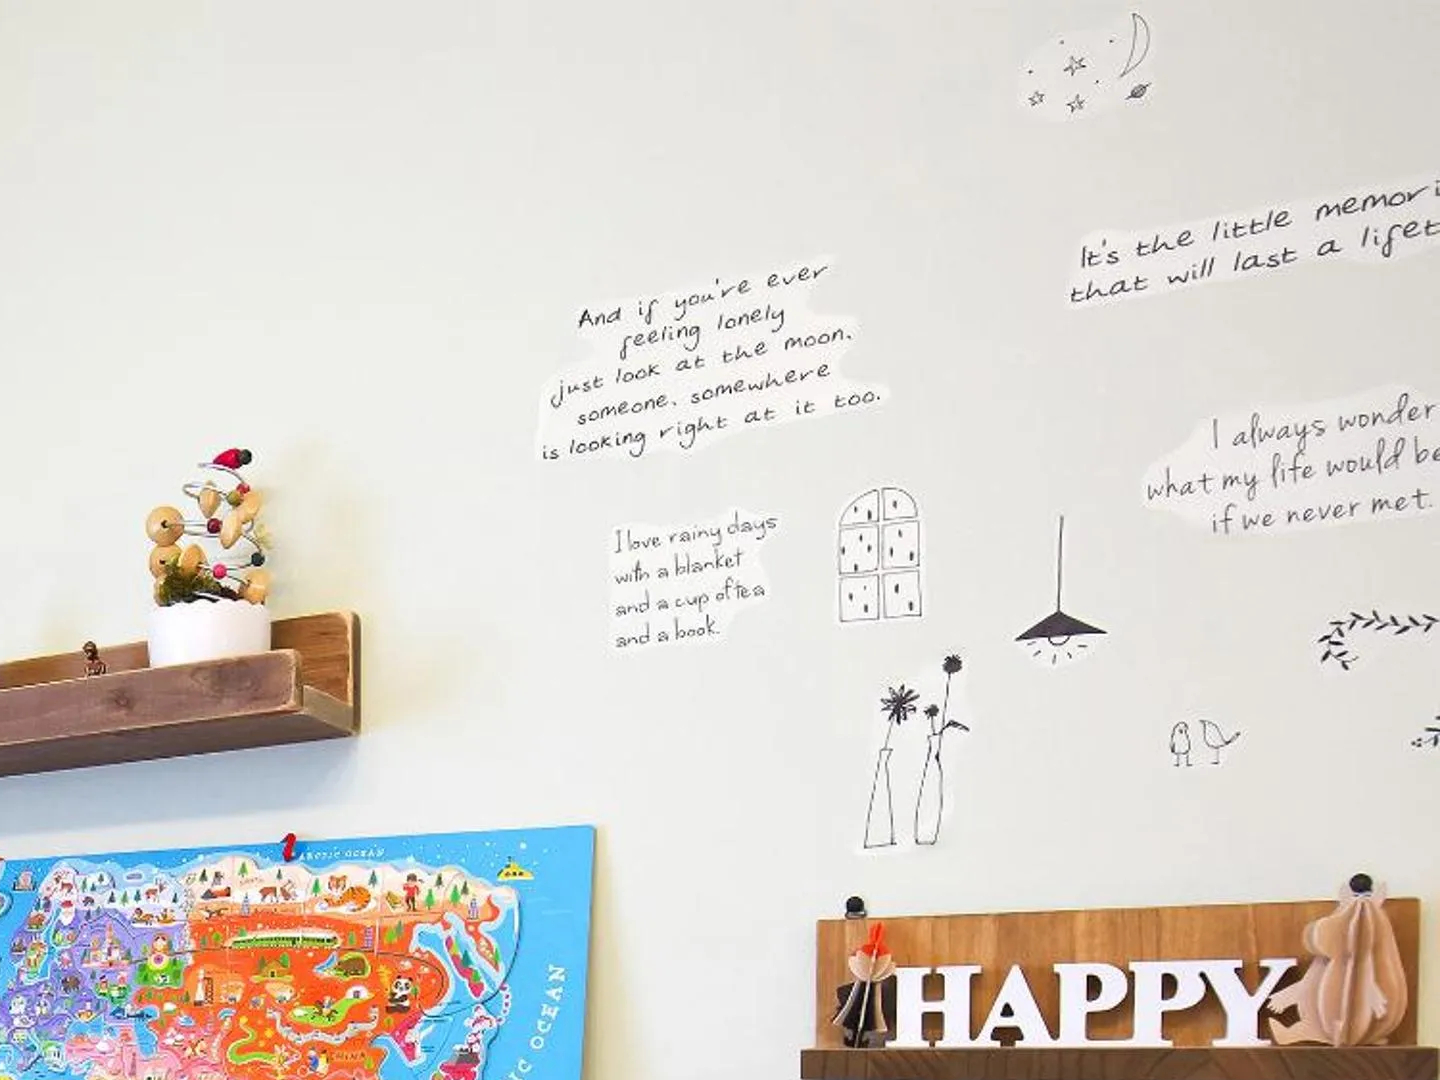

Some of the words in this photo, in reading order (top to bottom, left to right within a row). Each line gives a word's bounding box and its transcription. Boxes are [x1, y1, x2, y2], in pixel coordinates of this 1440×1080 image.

[1081, 239, 1119, 268] It's
[1136, 229, 1195, 257] the
[1212, 207, 1292, 241] little
[578, 307, 622, 328] And
[639, 299, 658, 324] if
[675, 278, 751, 321] you're
[767, 264, 828, 287] ever
[1070, 275, 1149, 303] that
[1167, 257, 1215, 286] will
[1233, 247, 1298, 272] last
[1316, 239, 1343, 256] a
[620, 325, 701, 360] feeling
[718, 304, 785, 332] lonely
[550, 376, 604, 408] just
[616, 364, 660, 384] look
[675, 357, 705, 372] at
[722, 342, 768, 363] the
[691, 363, 830, 404] somewhere
[542, 445, 559, 460] is
[570, 430, 646, 457] looking
[659, 416, 728, 449] right
[745, 407, 776, 423] at
[795, 399, 816, 415] it
[834, 390, 881, 409] too.
[1213, 418, 1218, 448] I
[1232, 412, 1327, 449] always
[1338, 393, 1436, 432] wonder
[1147, 466, 1213, 501] what
[1222, 471, 1259, 500] my
[1271, 449, 1314, 488] life
[1326, 437, 1406, 477] would
[614, 529, 623, 554] I
[627, 529, 661, 551] love
[668, 525, 723, 547] rainy
[727, 510, 778, 541] days
[1211, 502, 1237, 534] if
[1242, 512, 1276, 531] we
[1287, 500, 1361, 525] never
[614, 560, 650, 584] with
[657, 567, 669, 579] a
[675, 547, 743, 577] blanket
[615, 588, 650, 617] and
[656, 599, 669, 611] a
[675, 593, 710, 613] cup
[715, 576, 733, 601] of
[734, 580, 765, 600] tea
[615, 621, 650, 648] and
[657, 631, 669, 643] a
[530, 964, 567, 1050] OCEAN
[886, 957, 1298, 1048] HAPPY
